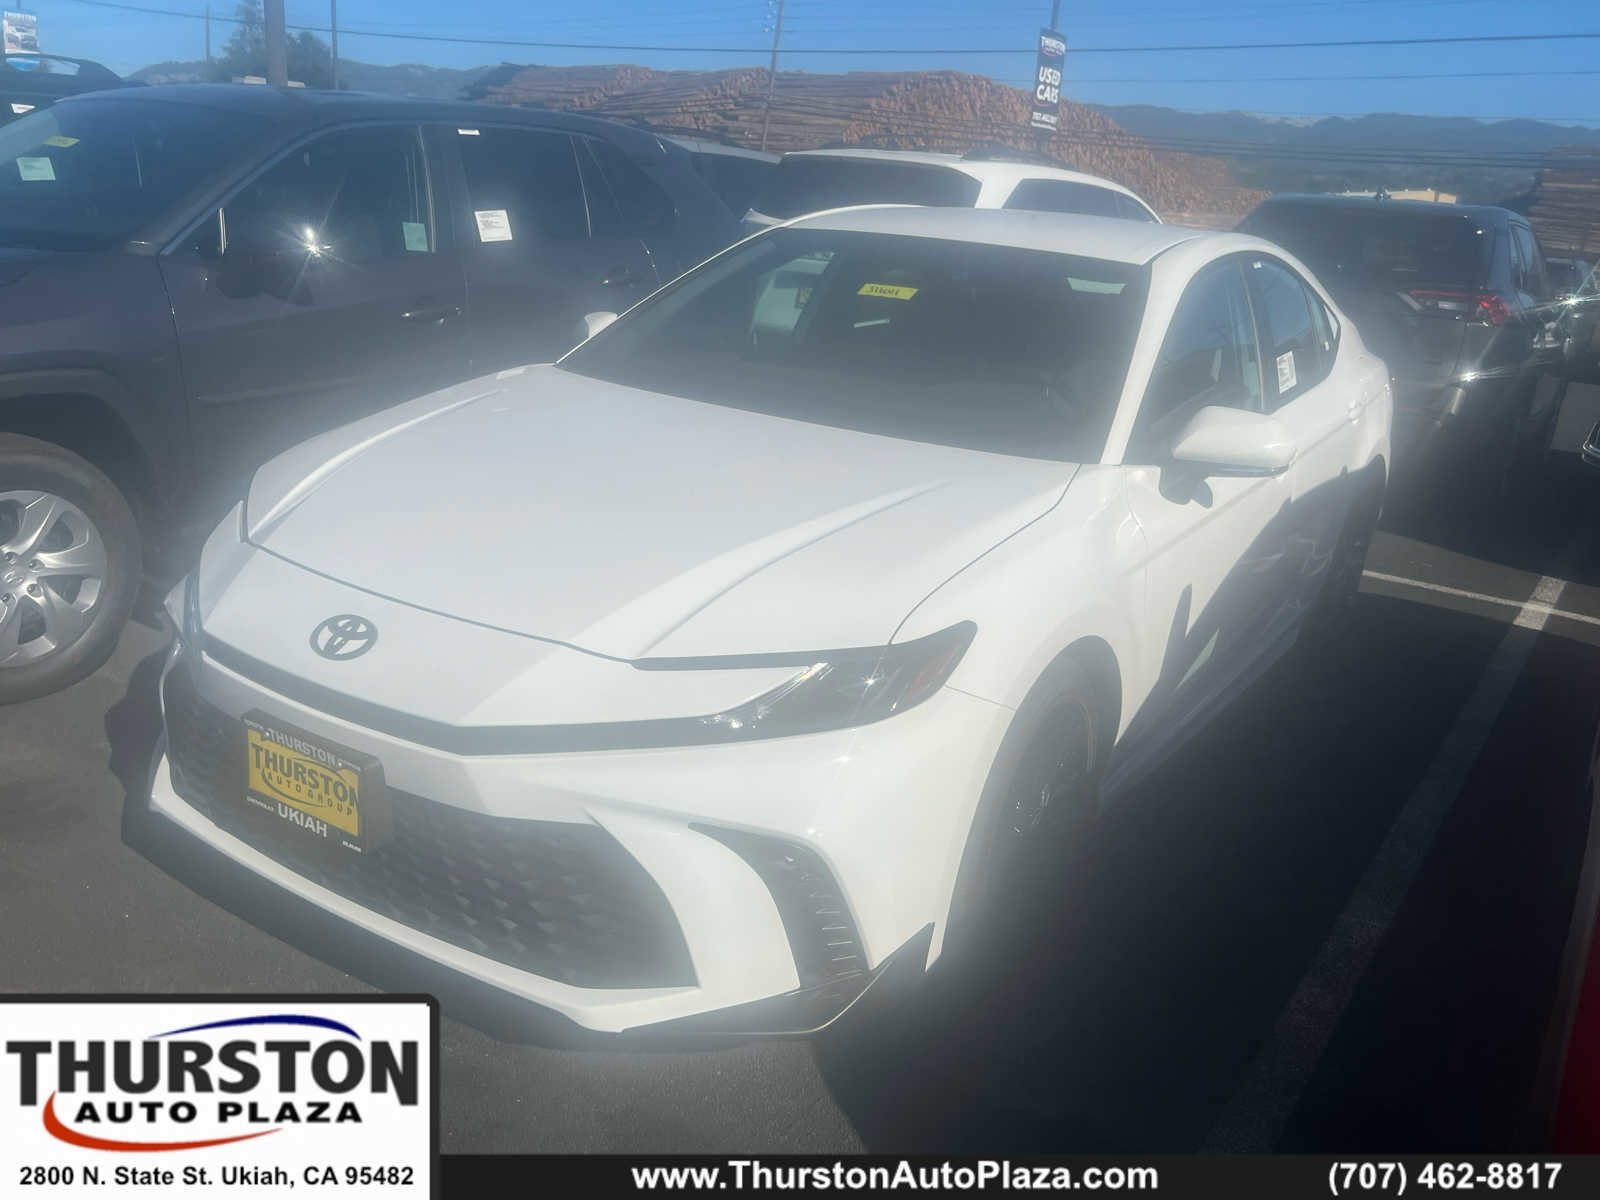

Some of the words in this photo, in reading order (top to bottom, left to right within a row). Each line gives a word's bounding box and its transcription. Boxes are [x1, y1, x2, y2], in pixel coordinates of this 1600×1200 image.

[1038, 65, 1061, 86] USED
[269, 729, 336, 765] THURSTON
[267, 770, 303, 794] AUTO
[307, 788, 353, 817] GROUP
[277, 802, 329, 838] UKIAH
